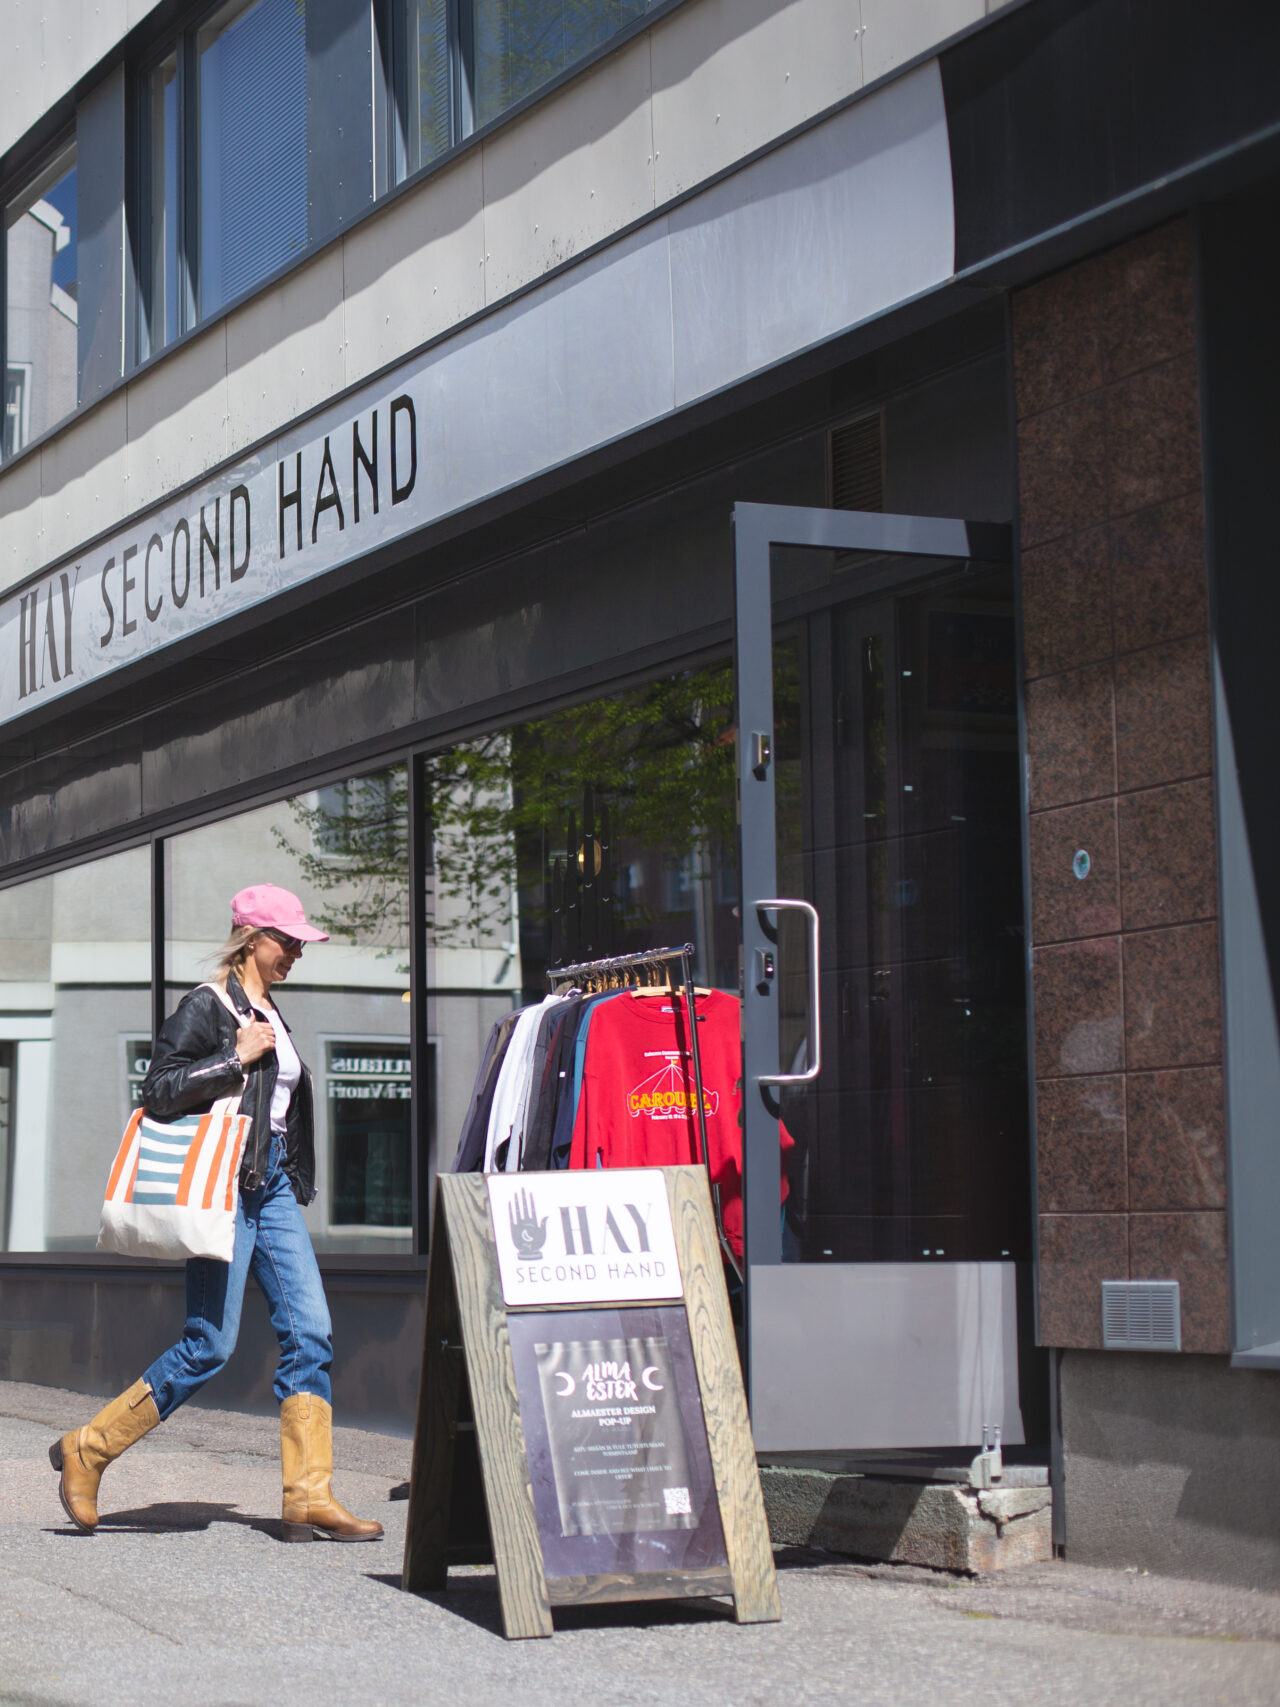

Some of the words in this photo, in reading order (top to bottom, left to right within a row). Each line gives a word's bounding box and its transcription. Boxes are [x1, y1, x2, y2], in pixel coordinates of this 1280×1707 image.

[18, 564, 82, 700] HAY
[100, 483, 252, 648] SECOND
[278, 394, 418, 559] HAND
[630, 1091, 712, 1110] CAROUEL
[558, 1203, 652, 1256] HAY
[516, 1264, 597, 1284] SECOND
[607, 1261, 666, 1280] HAND
[581, 1361, 631, 1382] ALMA
[586, 1380, 639, 1402] ESTER
[571, 1408, 623, 1418] ALMAESTER
[623, 1405, 657, 1415] DESIGN
[598, 1416, 632, 1427] POP-UP
